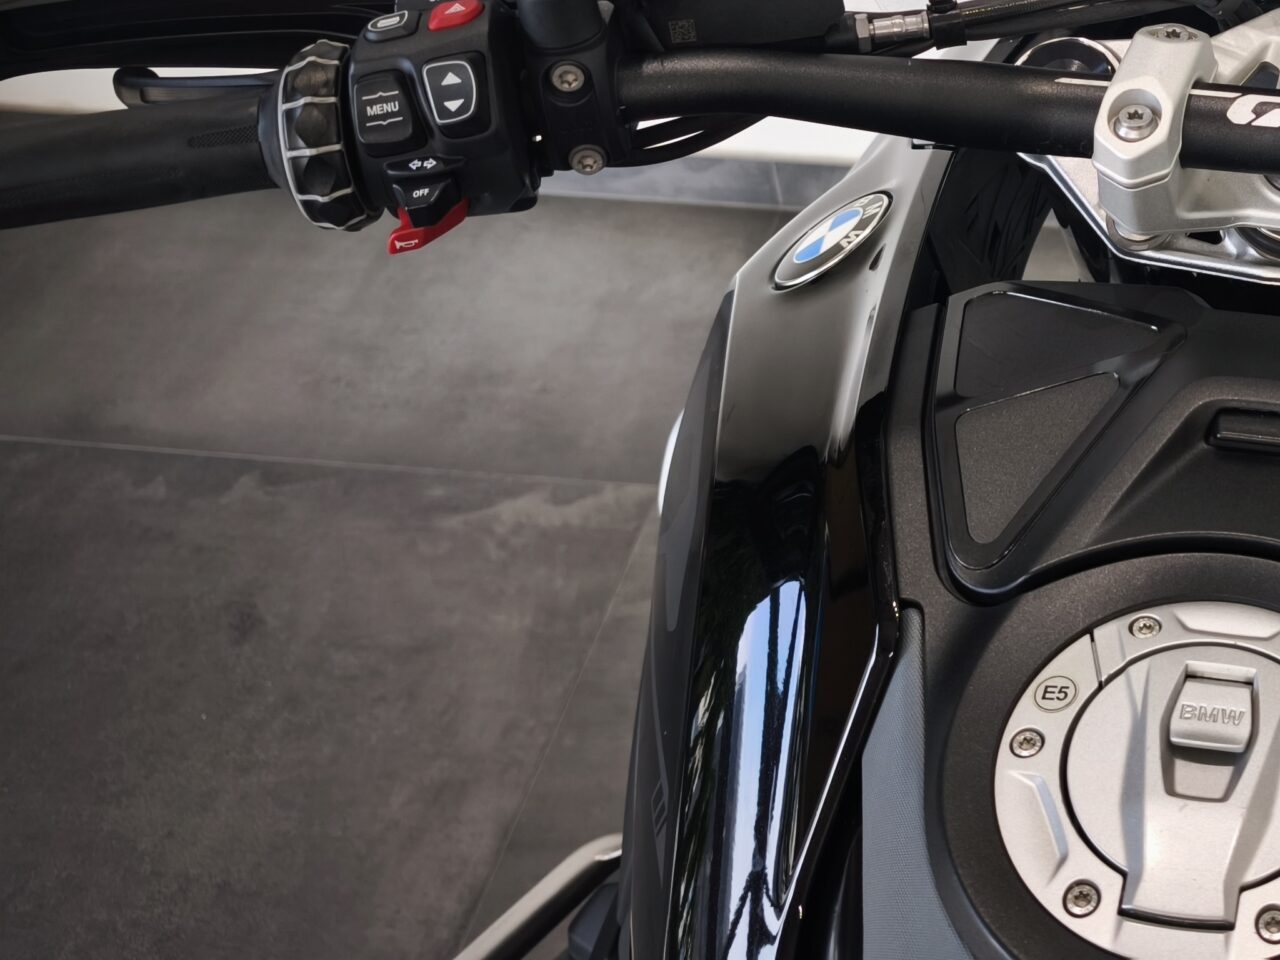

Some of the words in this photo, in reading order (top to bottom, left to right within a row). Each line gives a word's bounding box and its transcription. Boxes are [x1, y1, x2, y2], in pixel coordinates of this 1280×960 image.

[366, 101, 399, 117] MENU
[413, 187, 430, 198] OFF
[1041, 685, 1070, 702] E5
[1178, 703, 1246, 727] BMW
